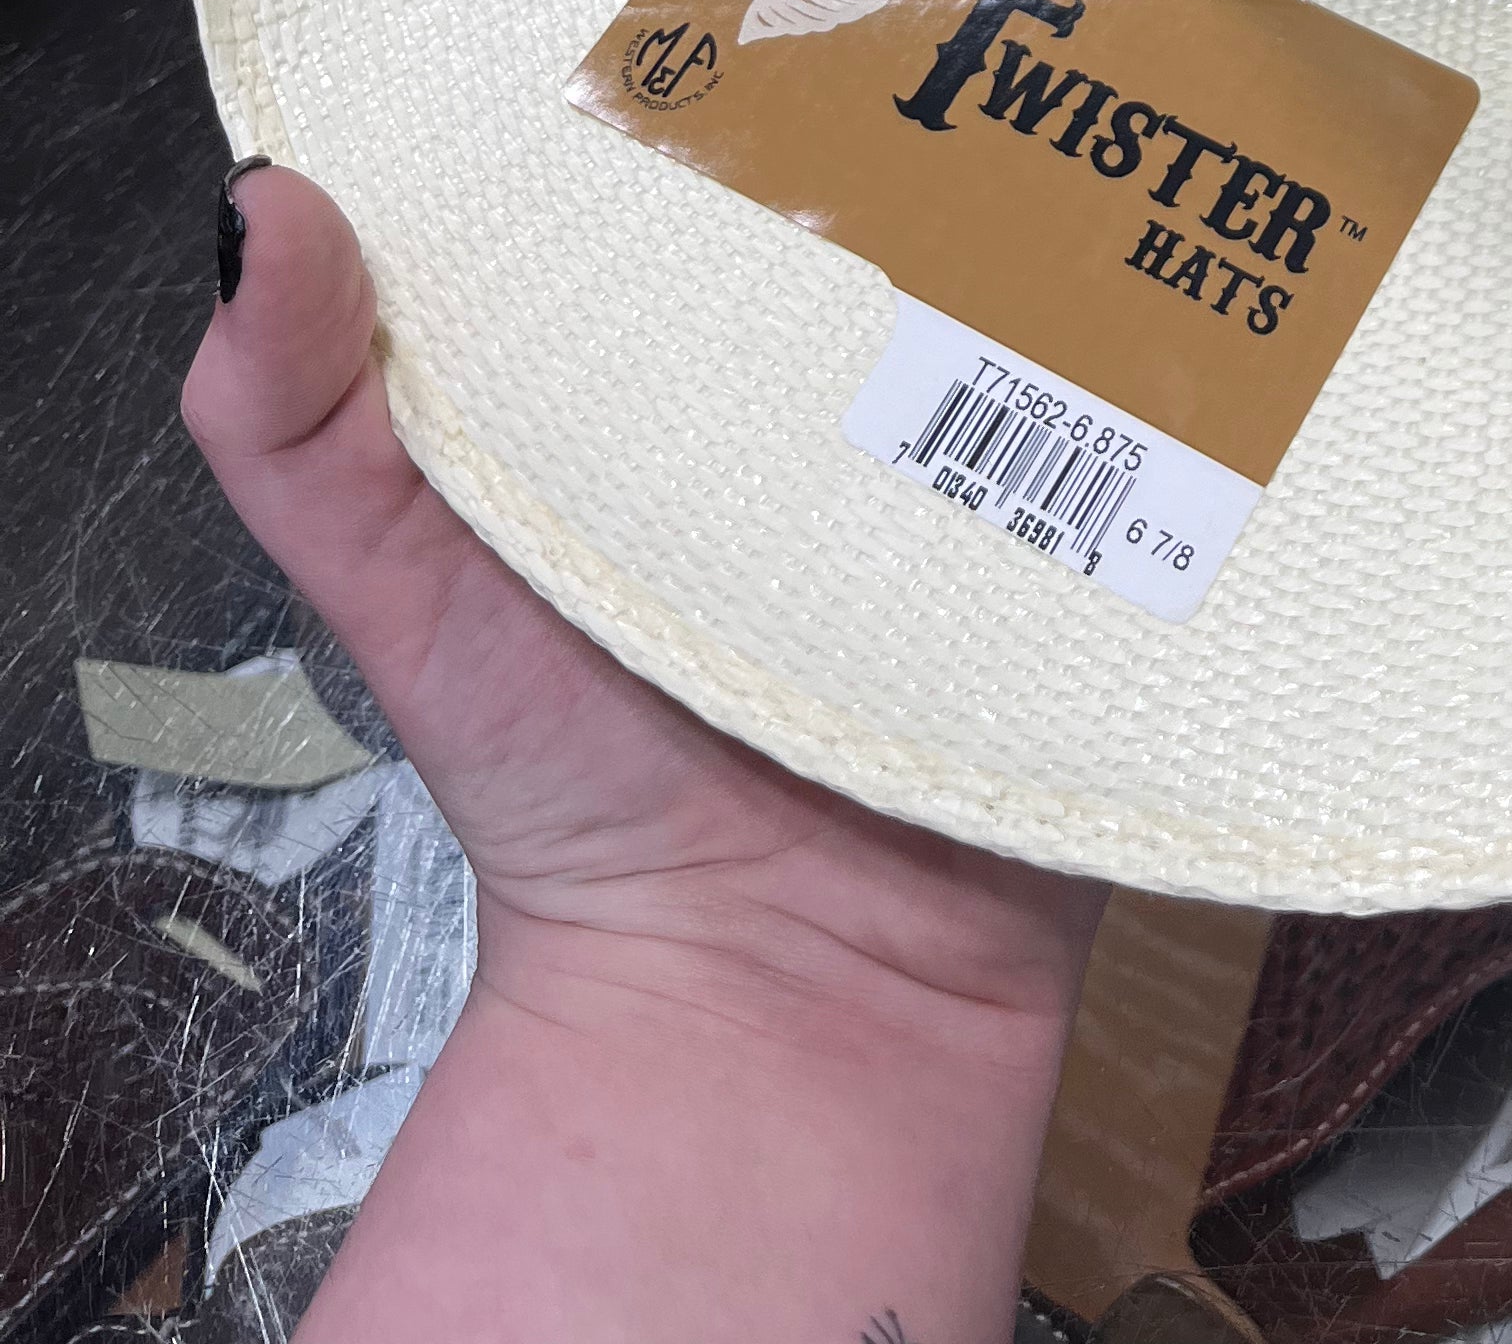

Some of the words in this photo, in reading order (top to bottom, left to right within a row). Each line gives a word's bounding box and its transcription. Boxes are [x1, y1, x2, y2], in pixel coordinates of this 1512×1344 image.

[621, 28, 650, 93] WESTERN
[1124, 219, 1294, 336] HATS
[972, 356, 1149, 471] T71562-6.875
[891, 441, 911, 464] 7
[932, 465, 989, 511] 01340
[1006, 507, 1066, 555] 36981
[1126, 518, 1149, 544] 6
[1151, 529, 1196, 571] 7/8
